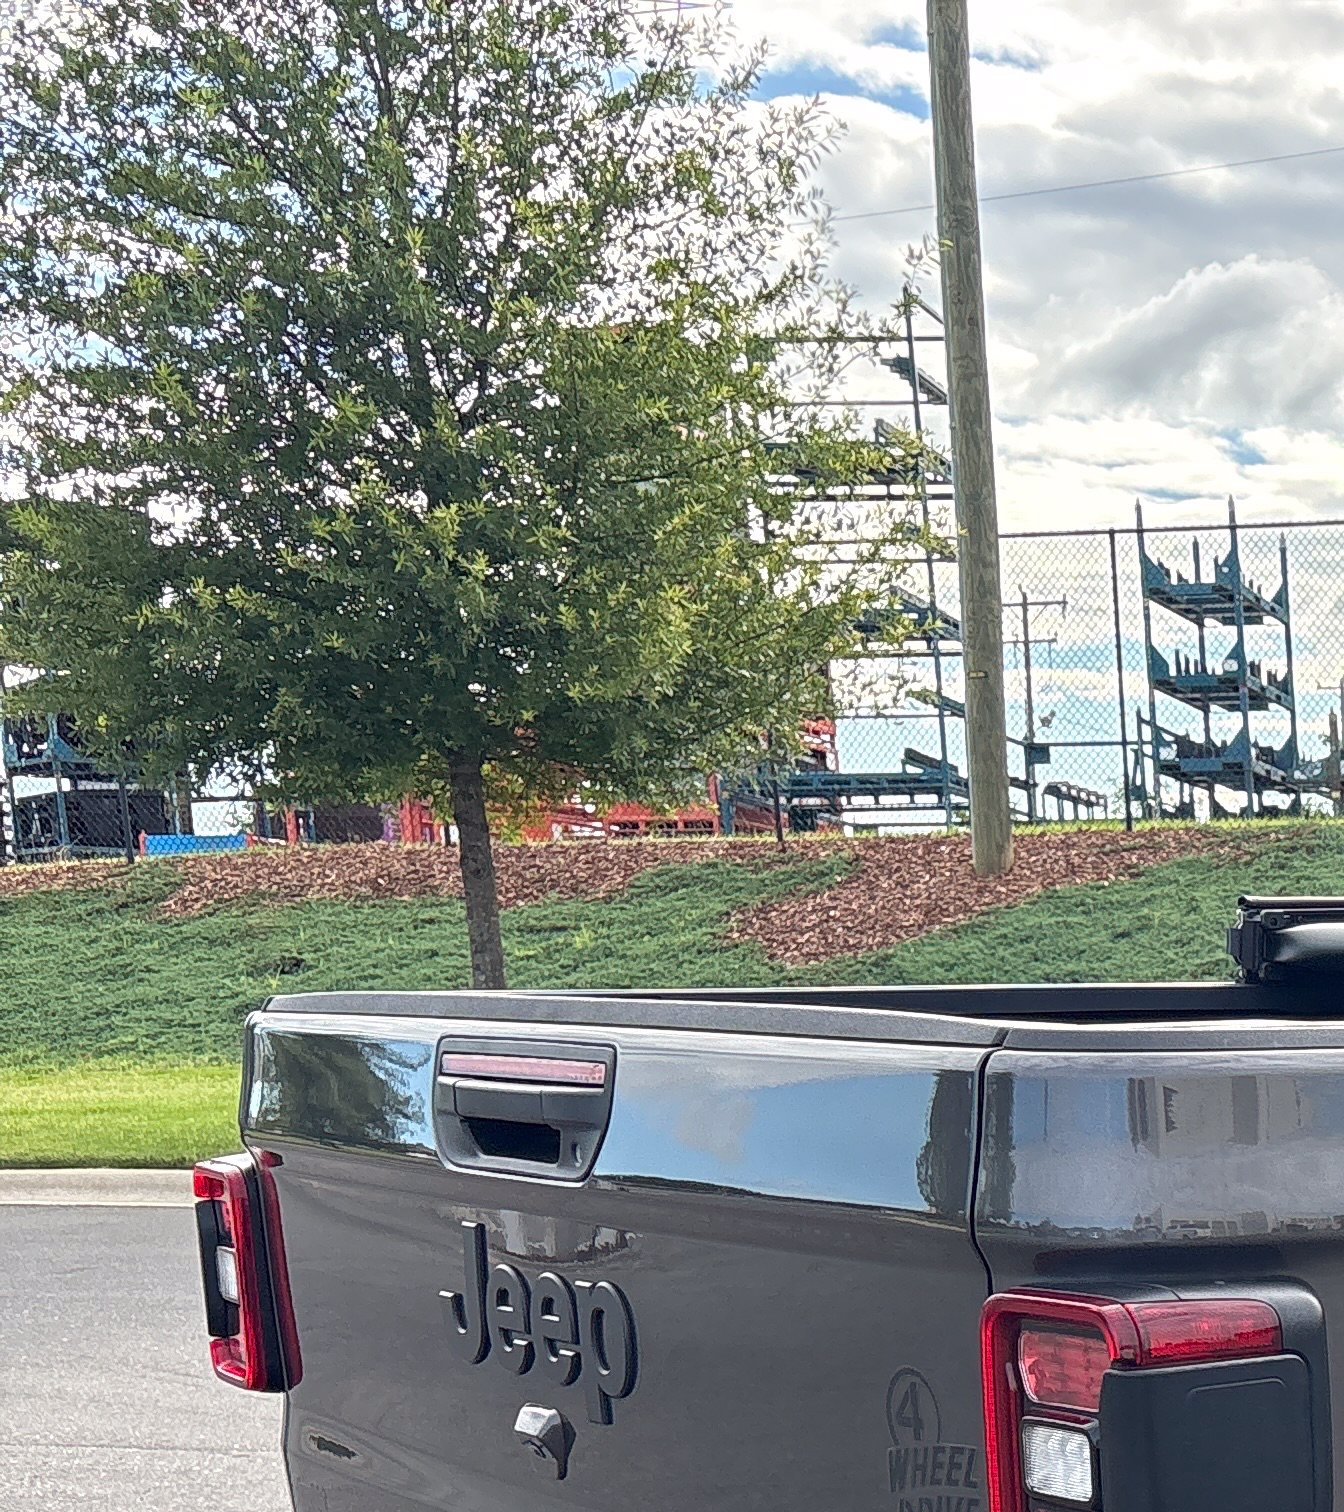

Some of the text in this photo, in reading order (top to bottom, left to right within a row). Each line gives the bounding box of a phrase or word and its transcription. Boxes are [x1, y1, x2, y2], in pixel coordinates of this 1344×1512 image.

[438, 1220, 639, 1425] Jeep
[897, 1381, 924, 1441] 4
[889, 1445, 979, 1492] WHEEL
